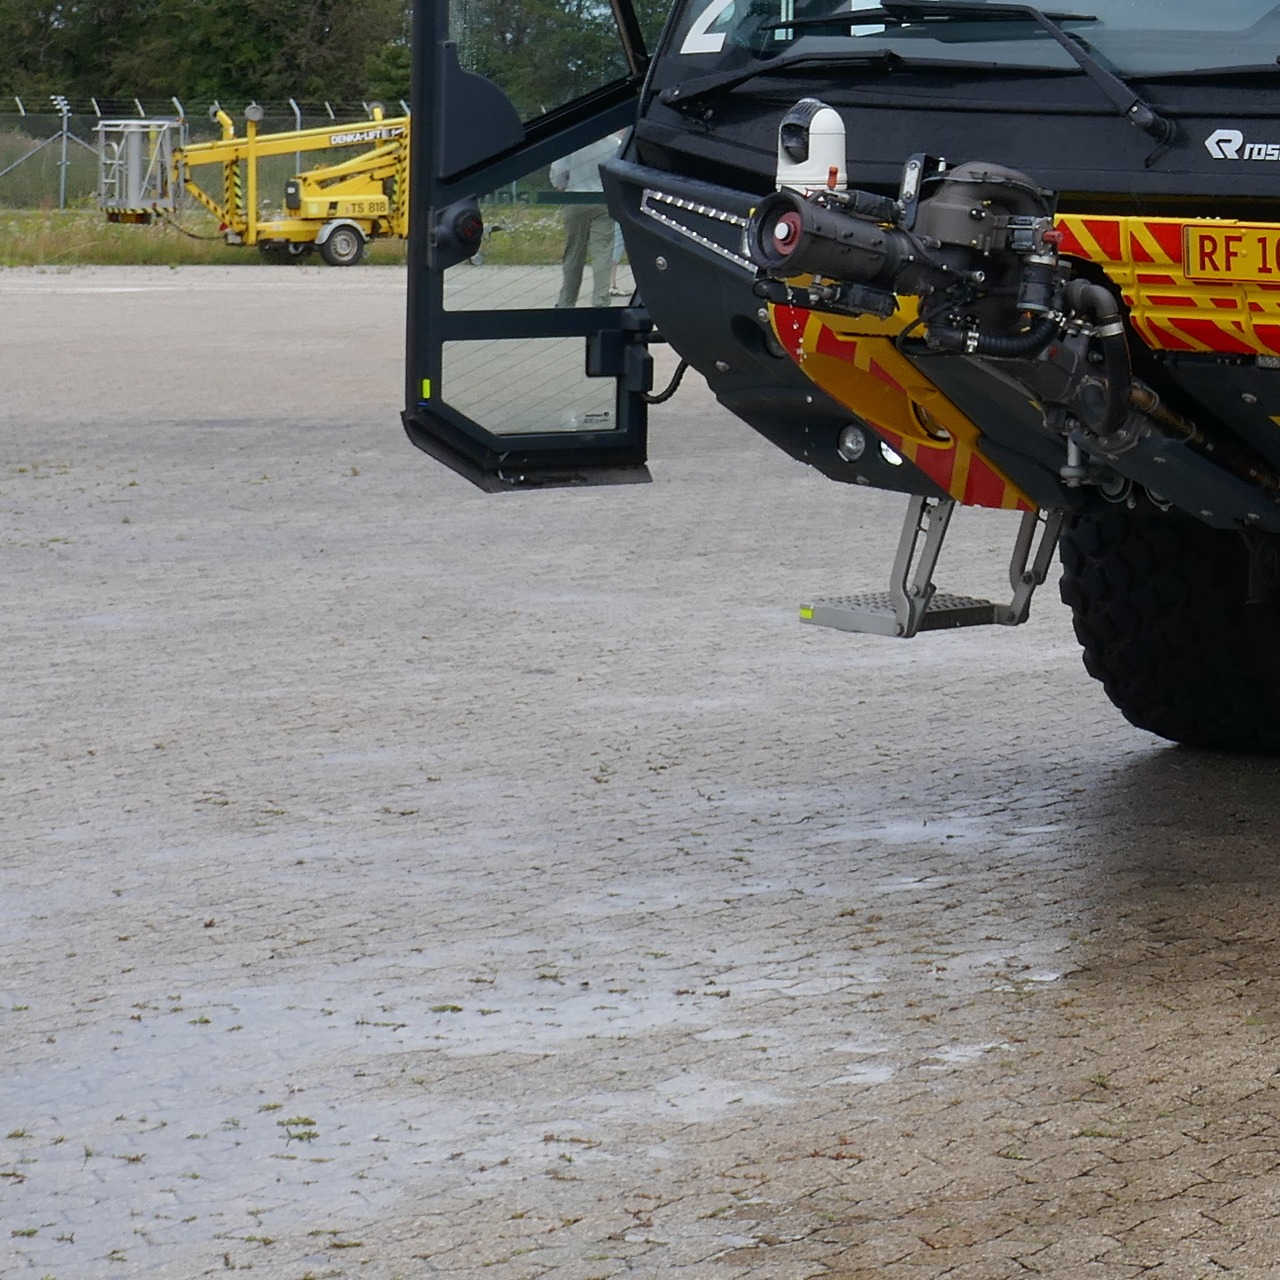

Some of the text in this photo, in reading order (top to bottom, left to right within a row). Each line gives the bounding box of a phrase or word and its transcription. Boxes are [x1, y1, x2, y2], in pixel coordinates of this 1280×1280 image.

[351, 202, 387, 214] TS 818
[1198, 234, 1243, 272] RF
